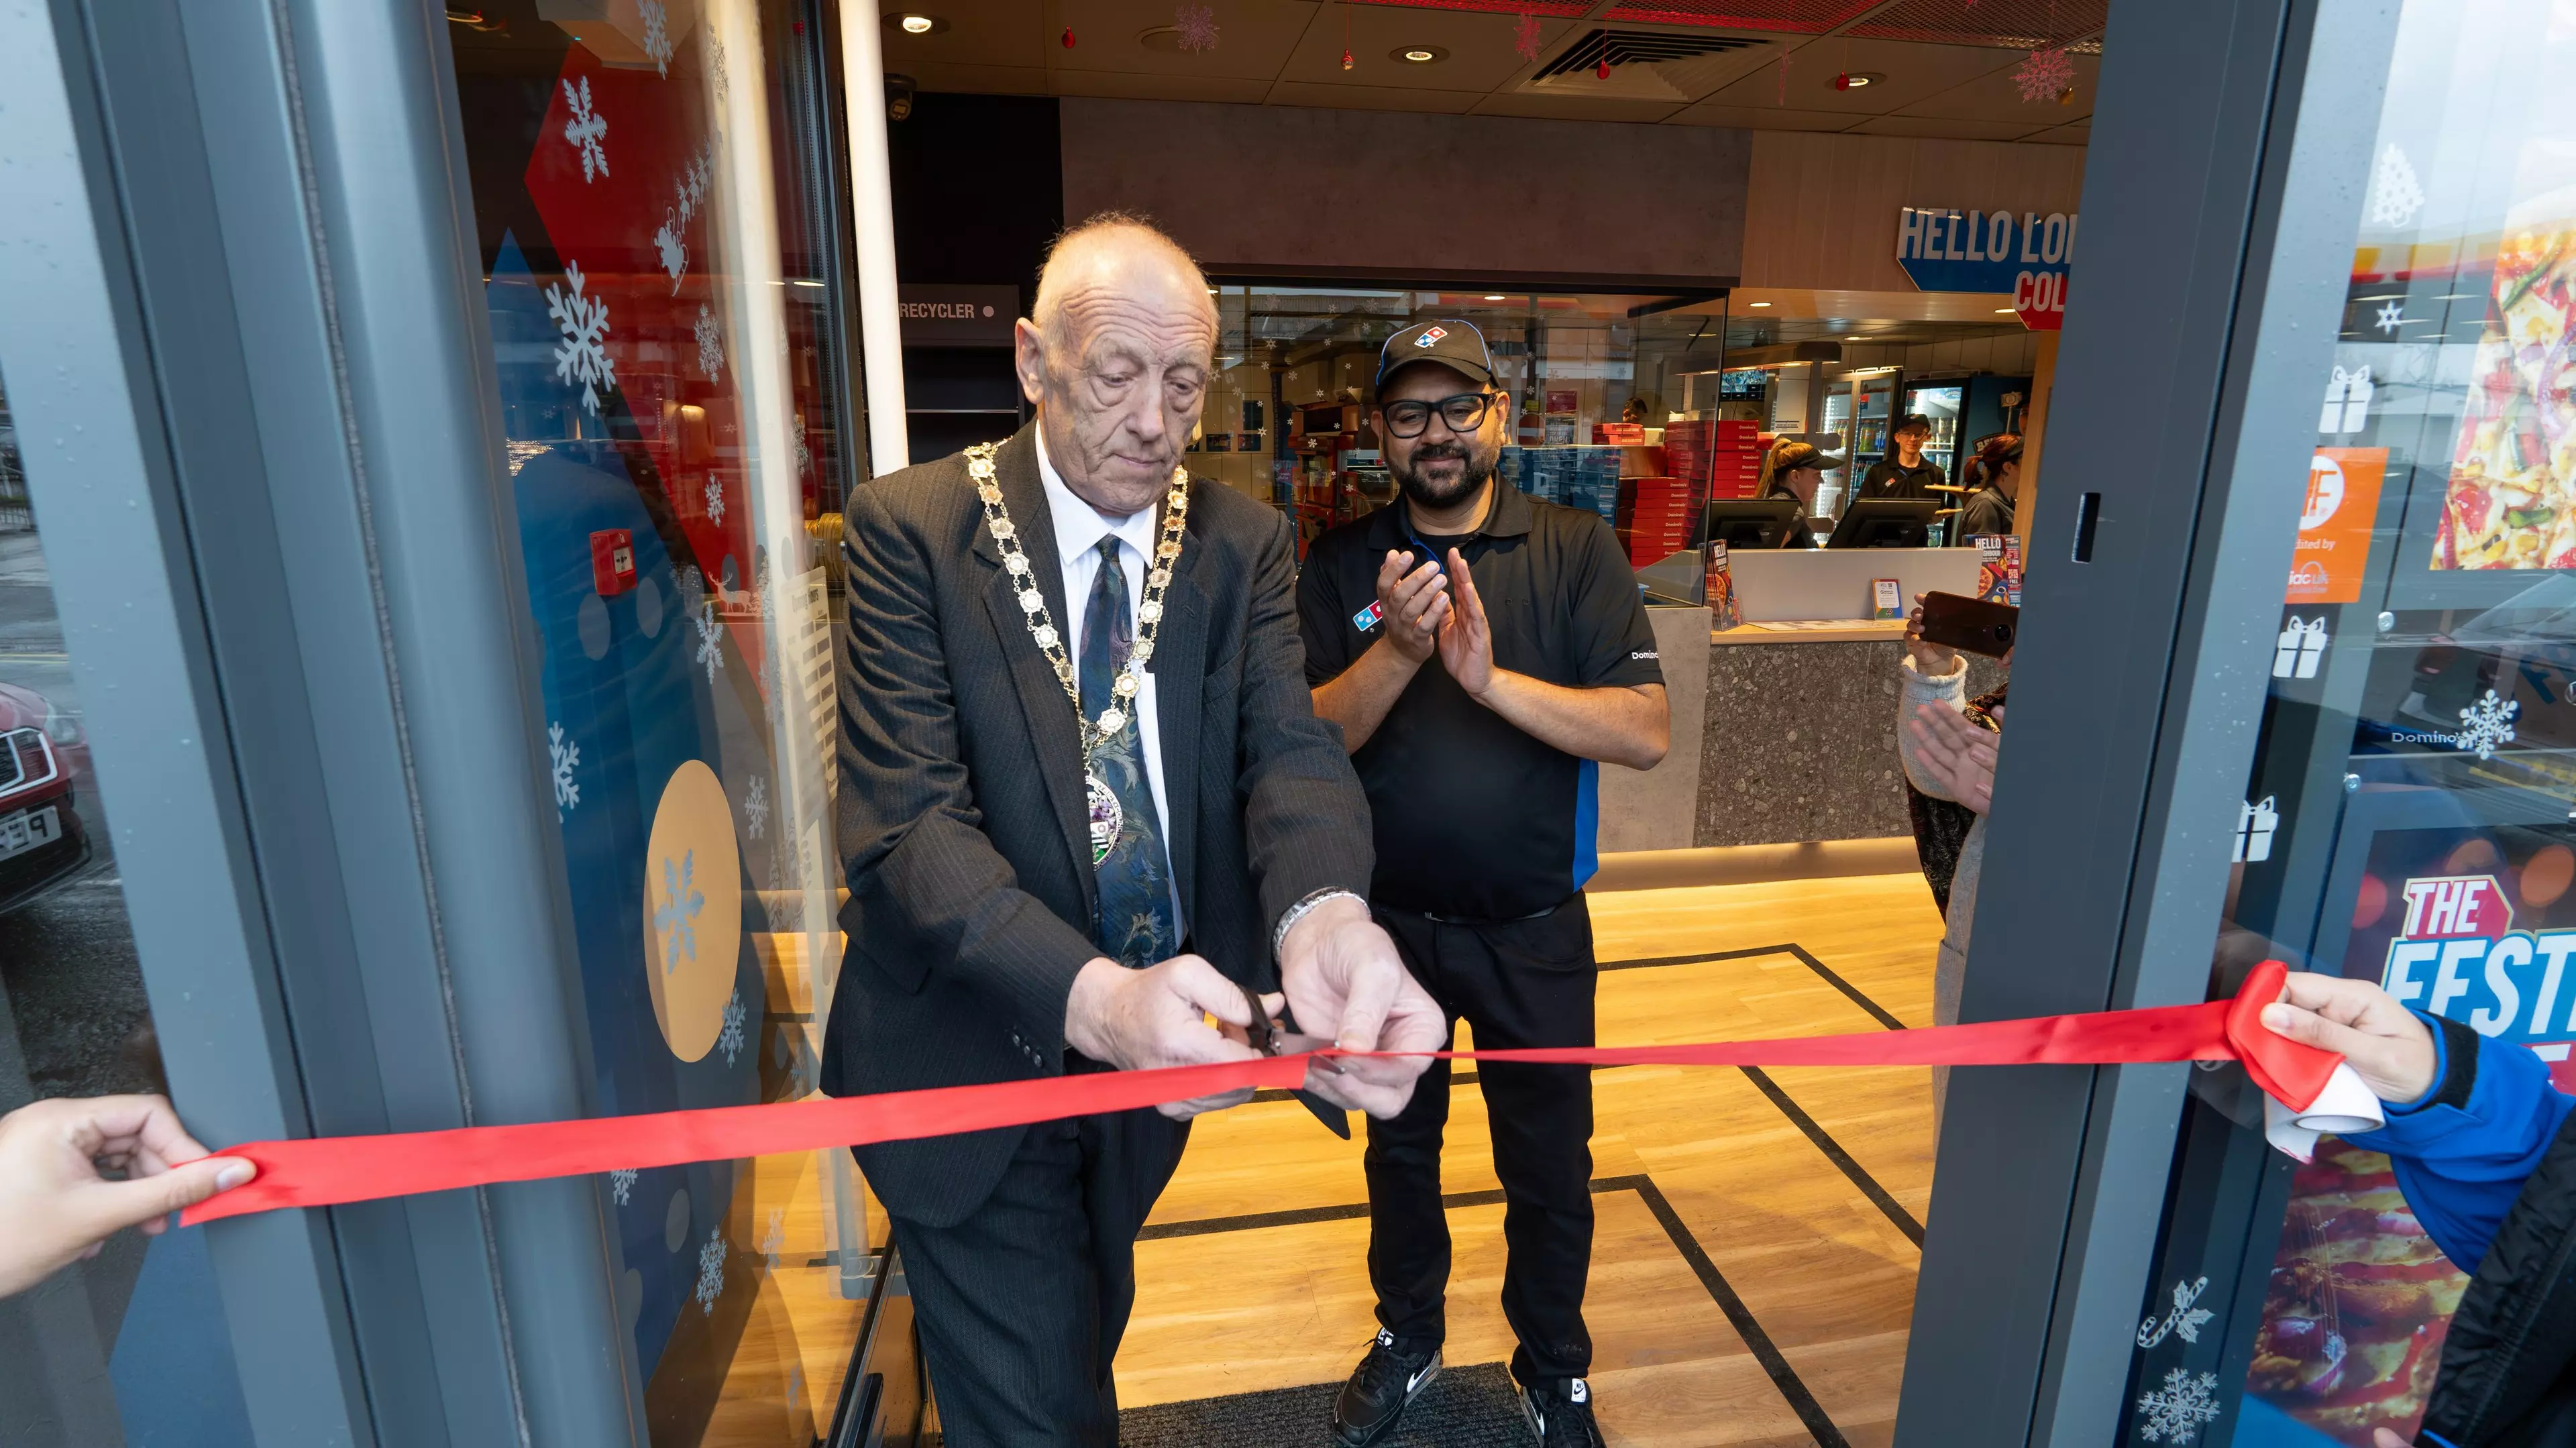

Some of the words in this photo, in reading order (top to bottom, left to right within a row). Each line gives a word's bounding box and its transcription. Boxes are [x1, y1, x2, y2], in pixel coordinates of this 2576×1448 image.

[1897, 207, 2012, 262] HELLO
[899, 303, 975, 319] RECYCLER
[1975, 537, 2001, 550] HELLO
[2322, 539, 2336, 551] by
[2407, 880, 2488, 936] THE
